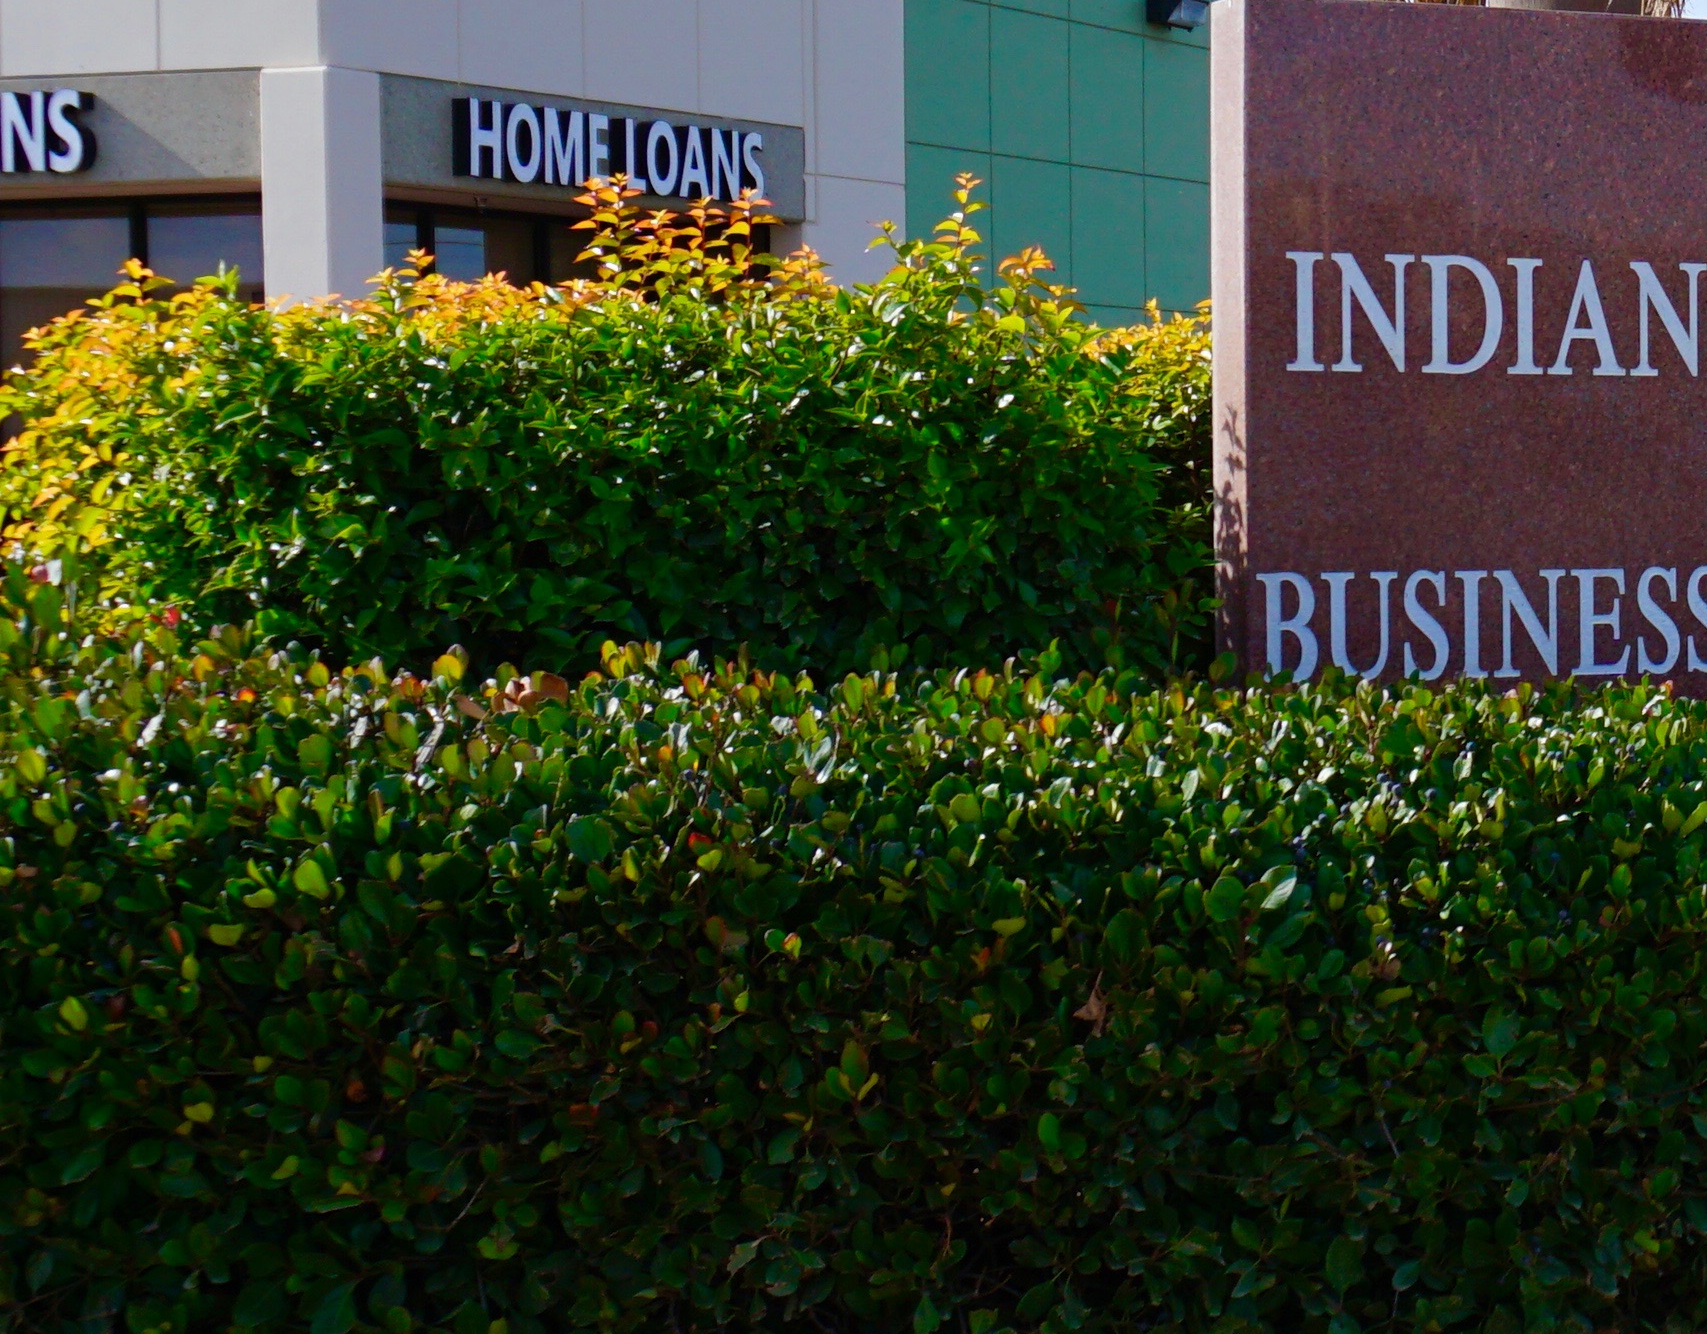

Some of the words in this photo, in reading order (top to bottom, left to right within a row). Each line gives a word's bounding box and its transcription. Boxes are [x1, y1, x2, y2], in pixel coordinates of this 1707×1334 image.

[469, 97, 609, 187] HOME
[625, 117, 765, 202] LOANS
[1285, 251, 1707, 377] INDIAN
